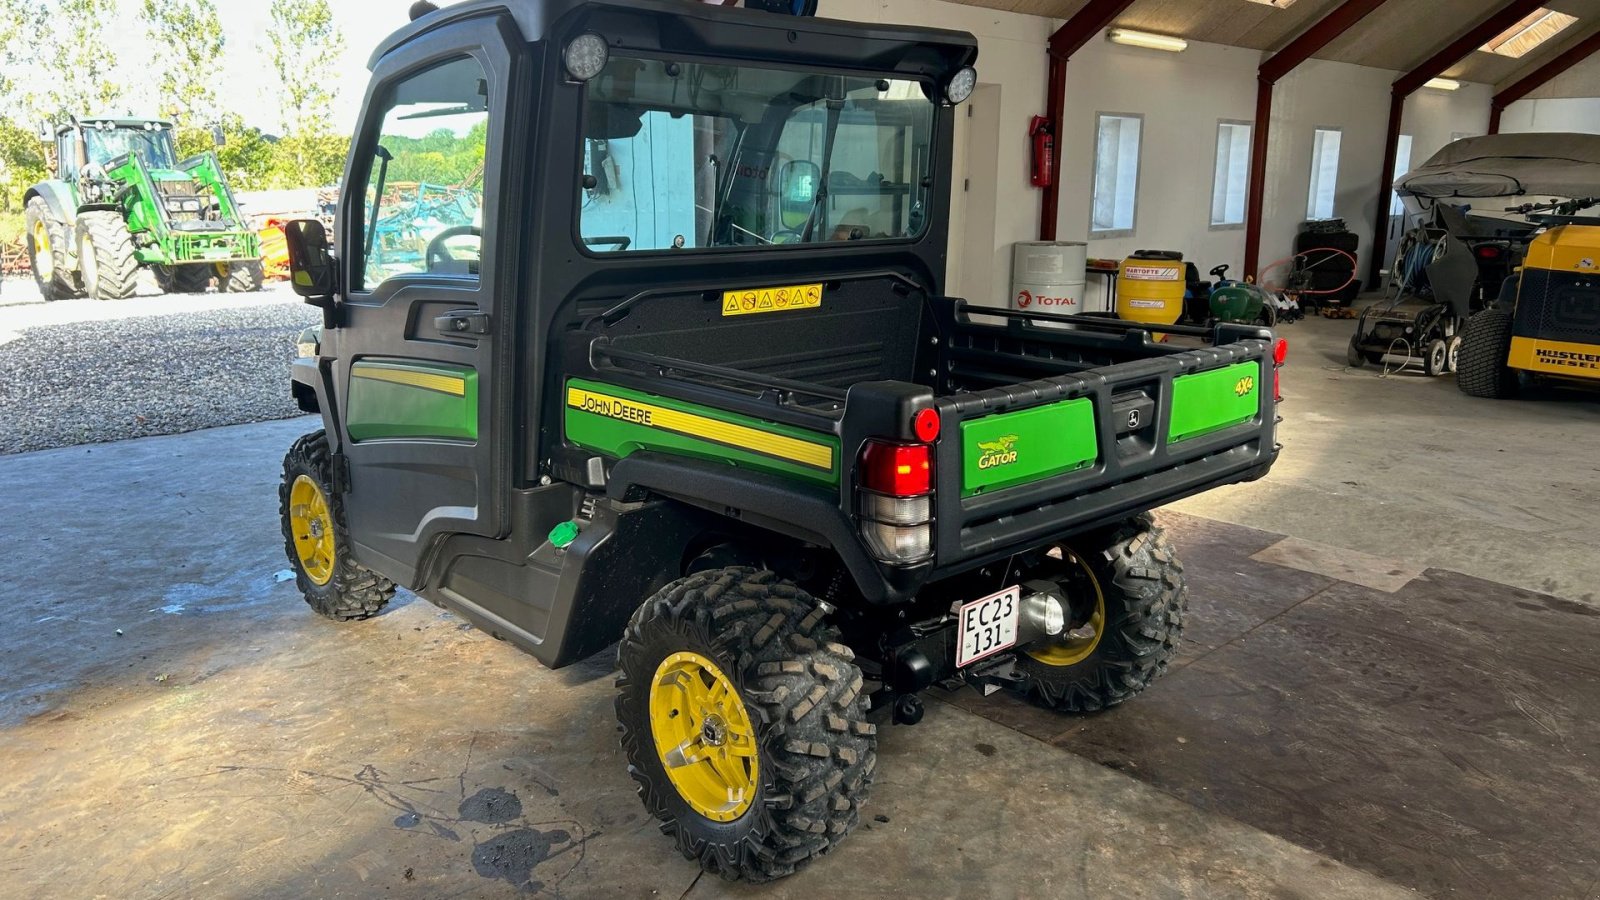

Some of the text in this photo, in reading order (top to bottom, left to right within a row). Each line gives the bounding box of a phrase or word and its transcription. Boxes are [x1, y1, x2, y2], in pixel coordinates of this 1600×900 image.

[1036, 296, 1076, 305] TOTAL
[1540, 357, 1599, 369] DIESEL
[581, 394, 652, 424] JOHN DEERE
[978, 451, 1018, 469] GATOR
[967, 594, 1012, 632] EC23
[973, 623, 1001, 655] 131
